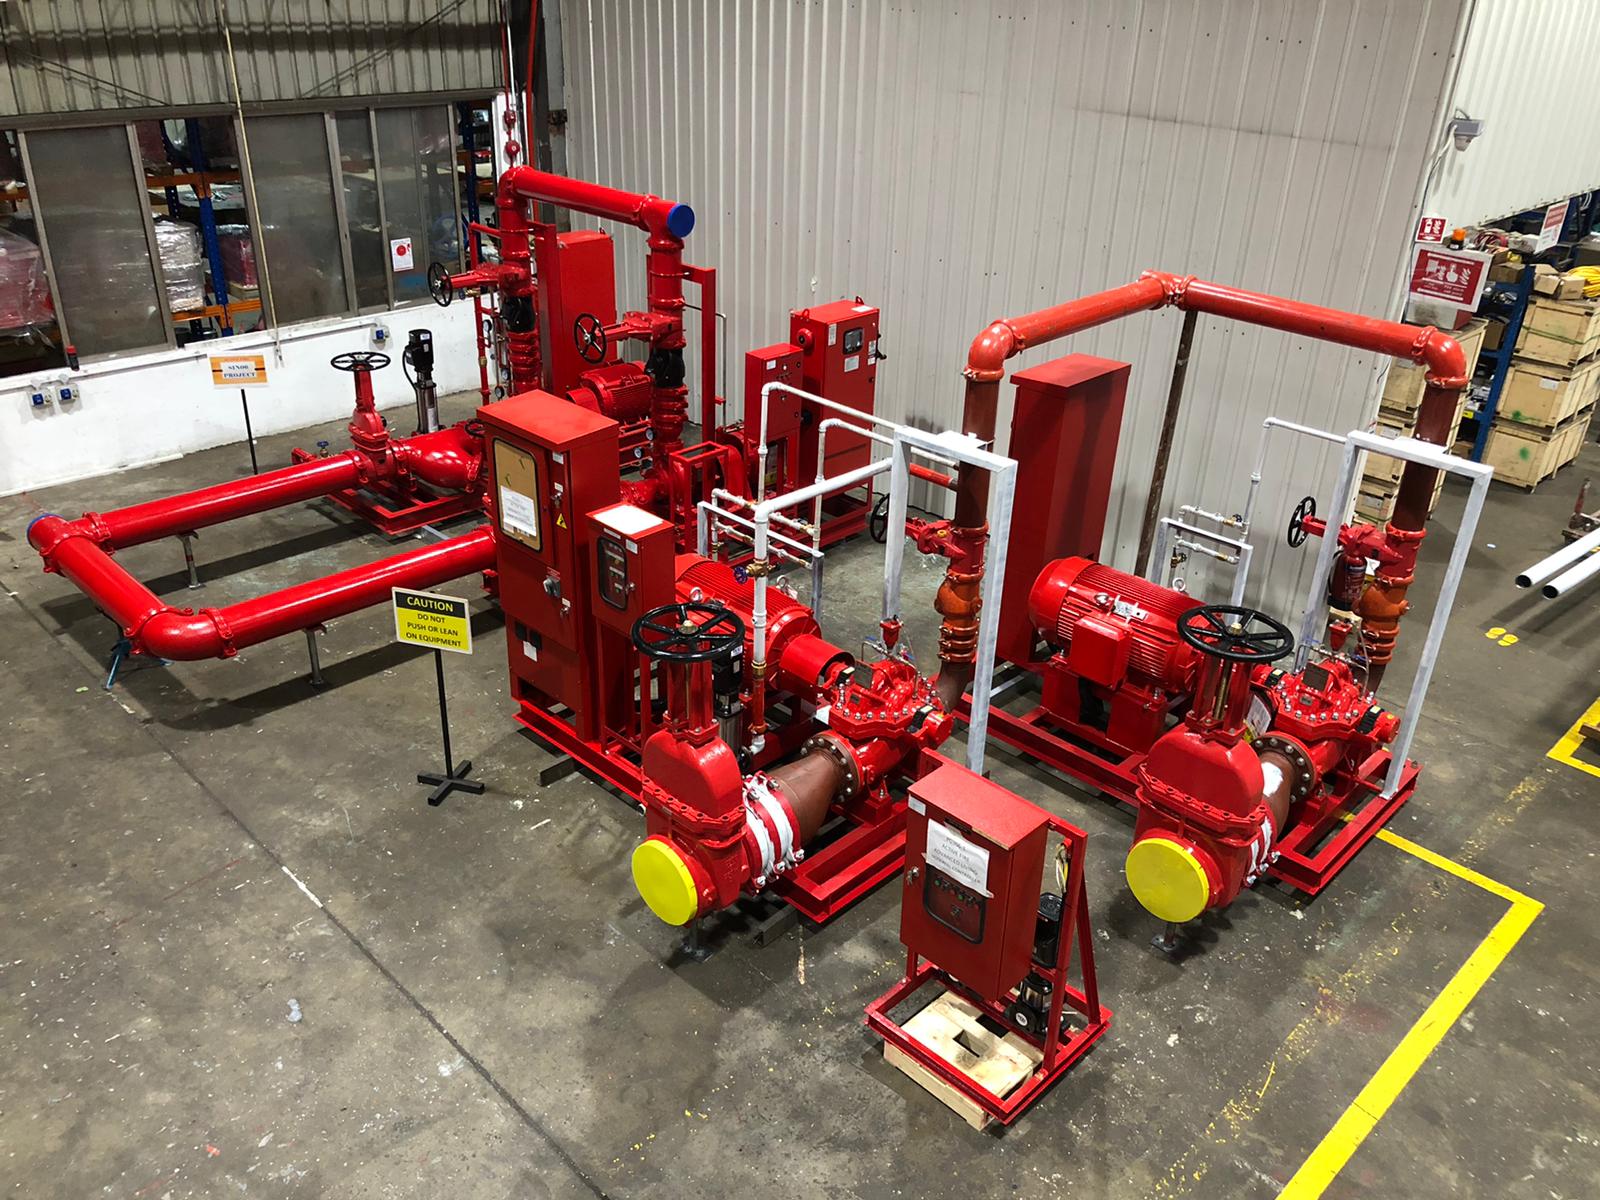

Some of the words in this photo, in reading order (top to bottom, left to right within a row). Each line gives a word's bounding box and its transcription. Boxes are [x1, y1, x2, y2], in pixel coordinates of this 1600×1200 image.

[407, 596, 454, 612] CAUTION
[430, 615, 445, 623] NOT
[407, 622, 426, 631] PUSH
[428, 625, 438, 633] OR
[440, 628, 458, 636] LEAN
[406, 632, 417, 640] ON
[419, 635, 461, 647] EQUIPMENT
